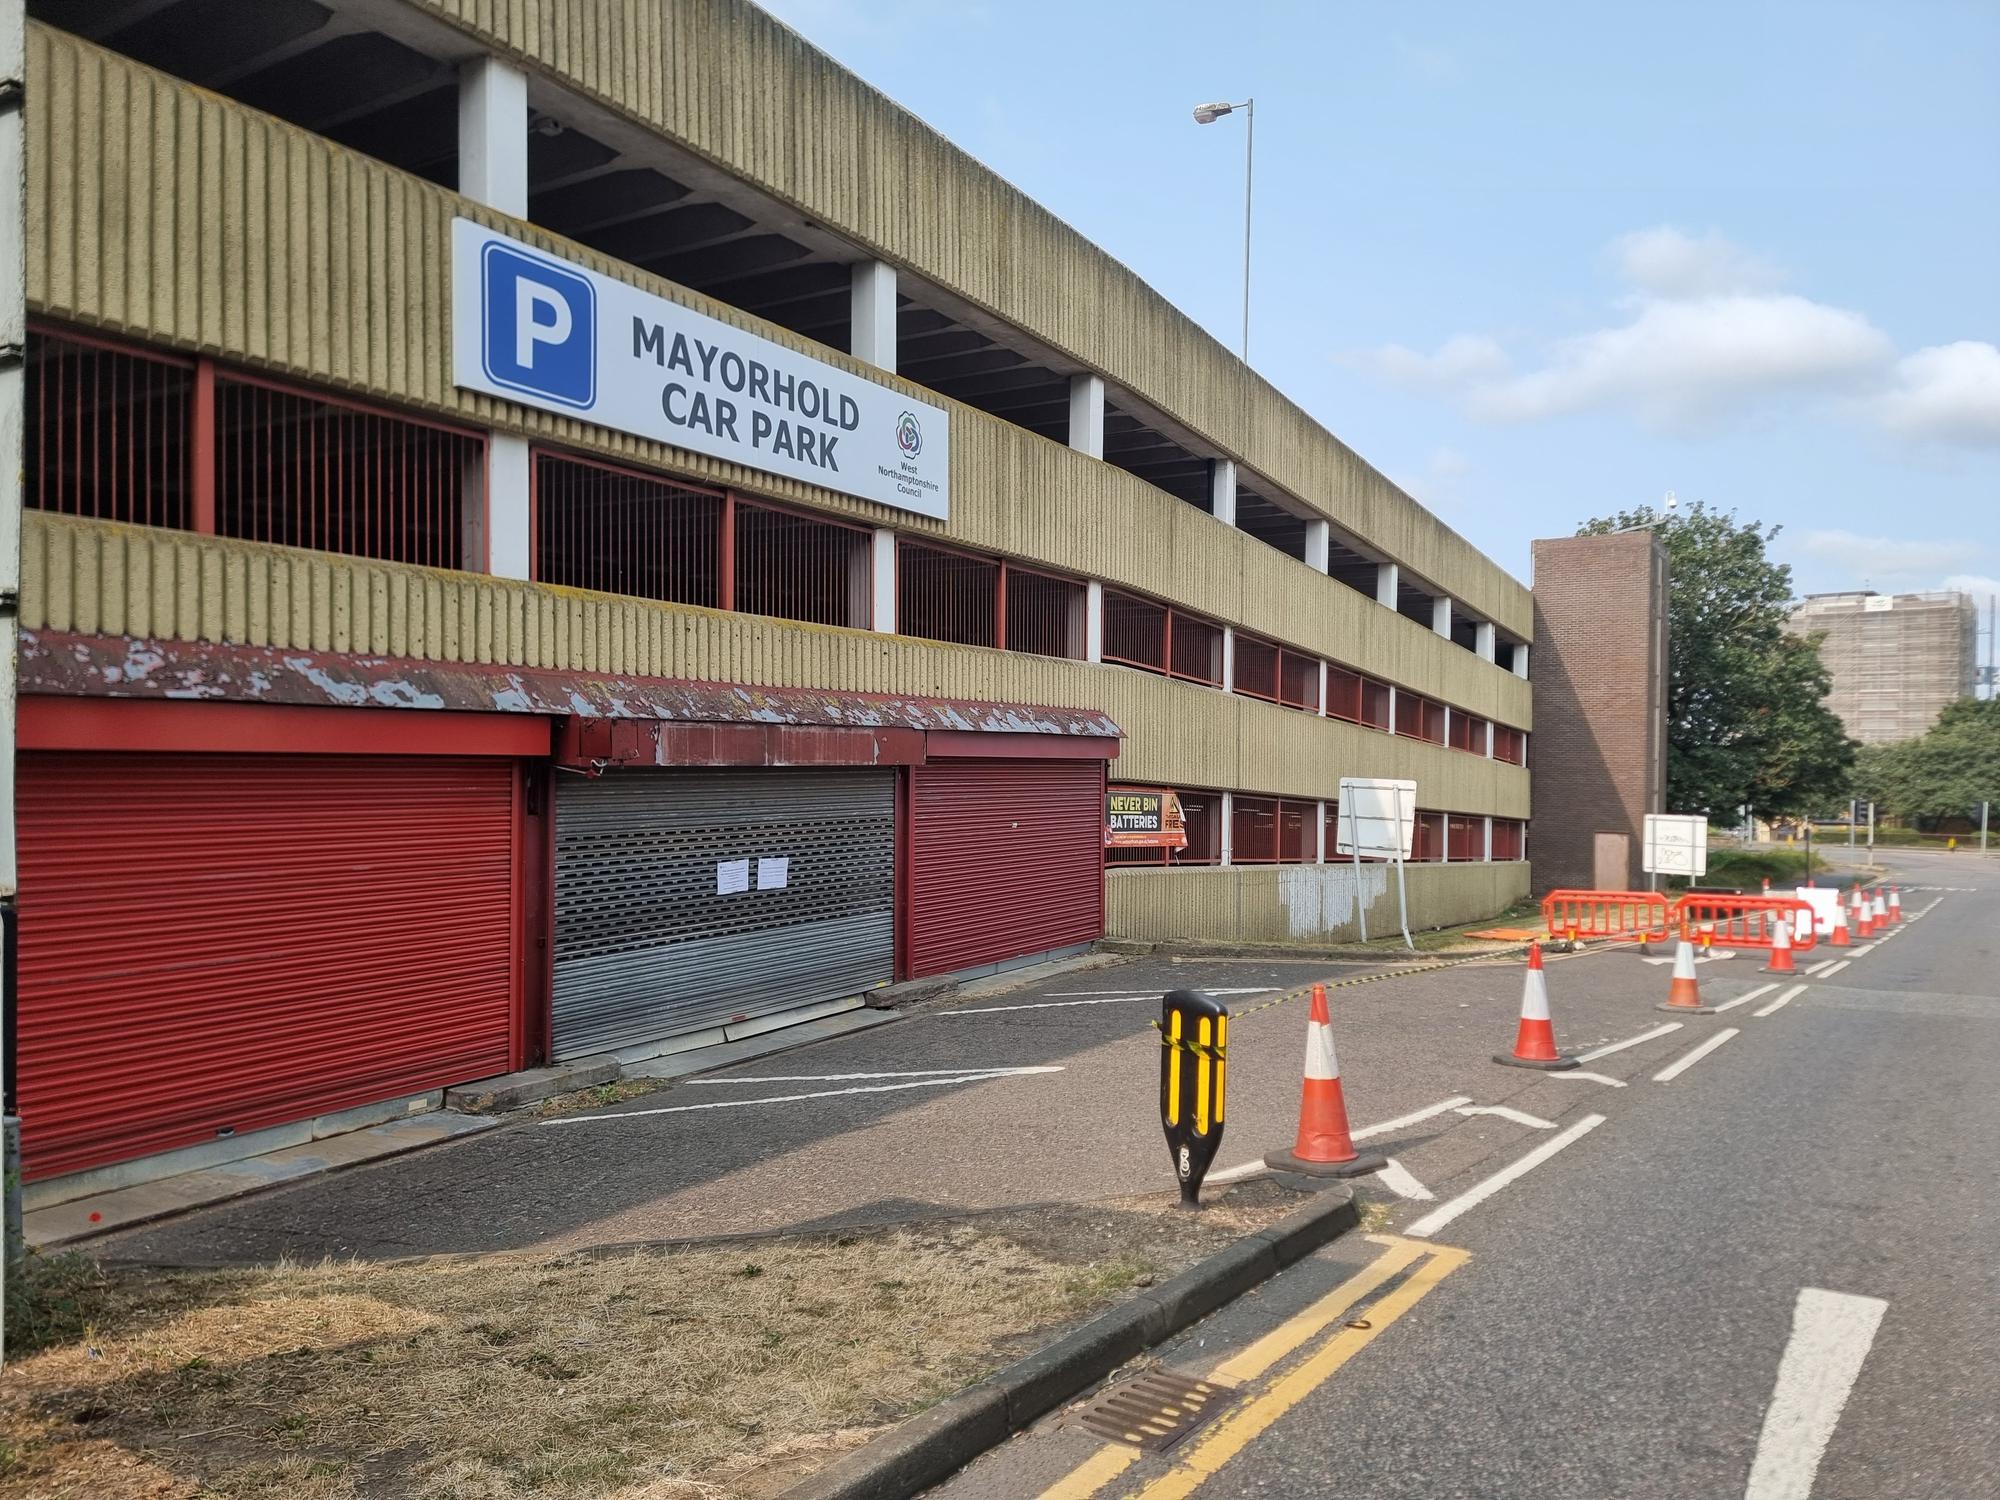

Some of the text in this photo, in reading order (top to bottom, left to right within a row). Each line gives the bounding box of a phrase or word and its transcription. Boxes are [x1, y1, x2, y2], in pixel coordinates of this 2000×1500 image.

[515, 275, 573, 369] P
[632, 316, 860, 431] MAYORHOLD
[661, 382, 840, 472] CAR PARK
[878, 465, 939, 492] Northamptonshire
[901, 461, 918, 475] West
[897, 483, 922, 498] Council
[1110, 796, 1158, 811] NEVER BIN
[1110, 815, 1158, 829] BATTERIES
